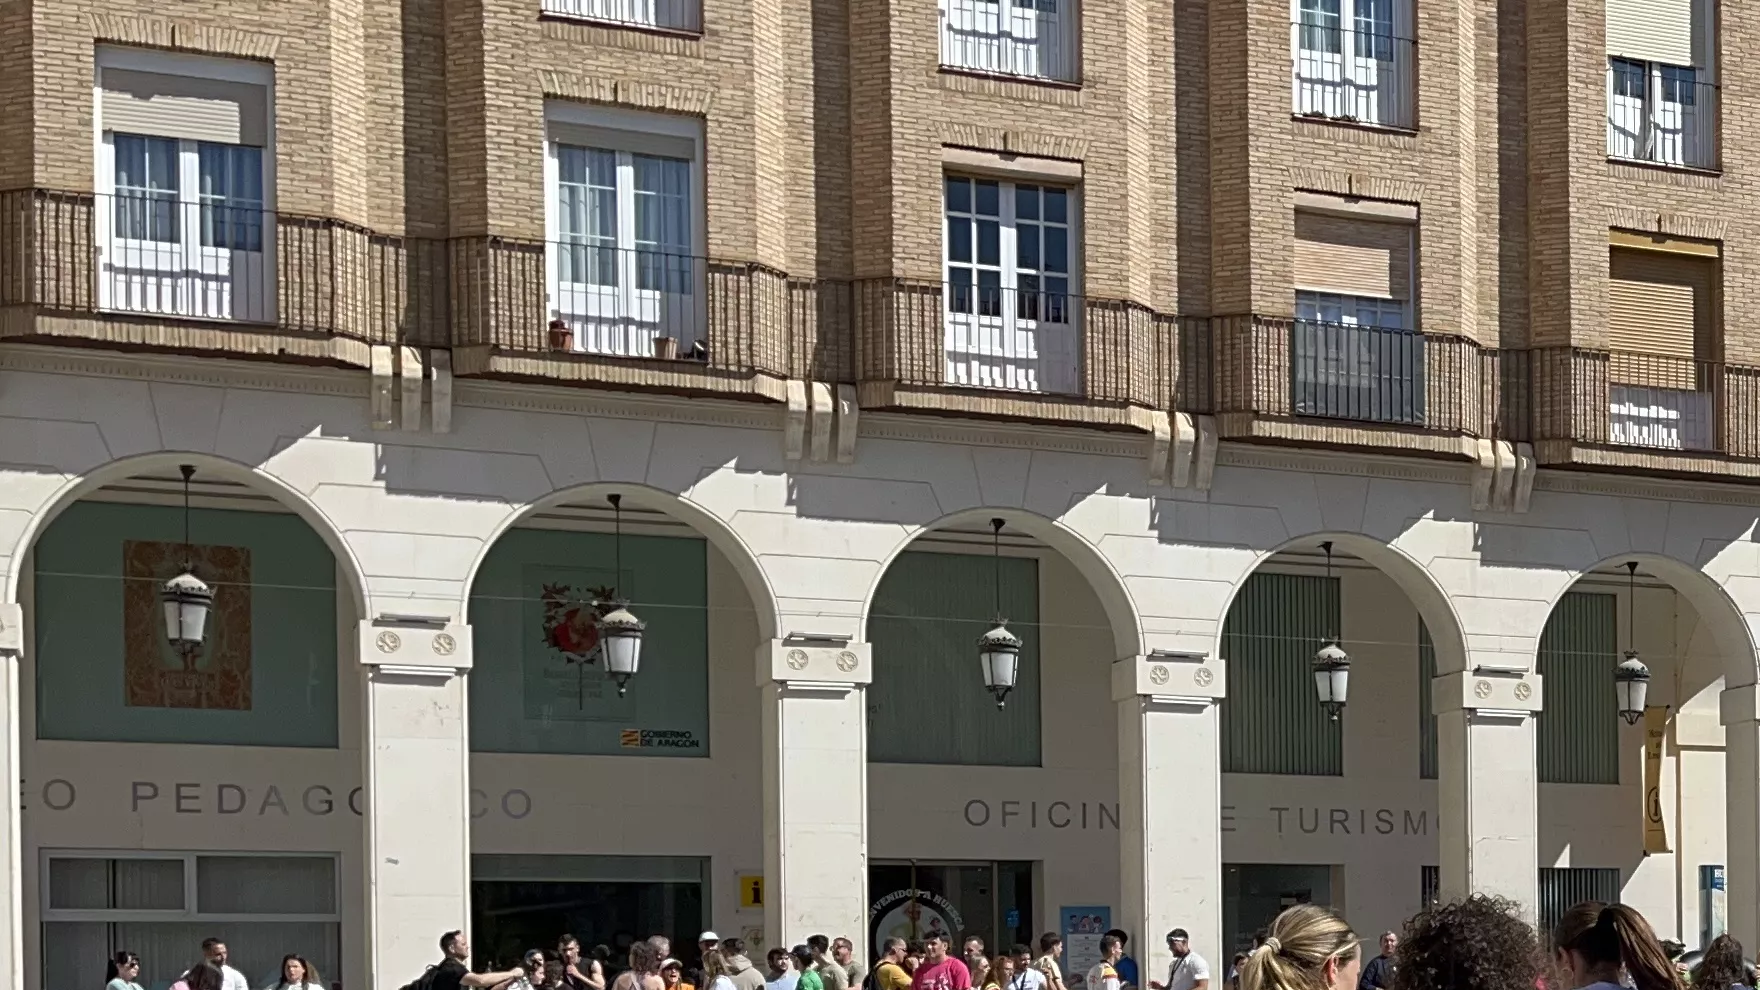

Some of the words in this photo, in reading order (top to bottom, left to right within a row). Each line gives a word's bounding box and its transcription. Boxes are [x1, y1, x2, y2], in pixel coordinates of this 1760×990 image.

[640, 729, 692, 739] GOBIERNO
[640, 739, 653, 747] DE
[964, 799, 1120, 830] OFICIN
